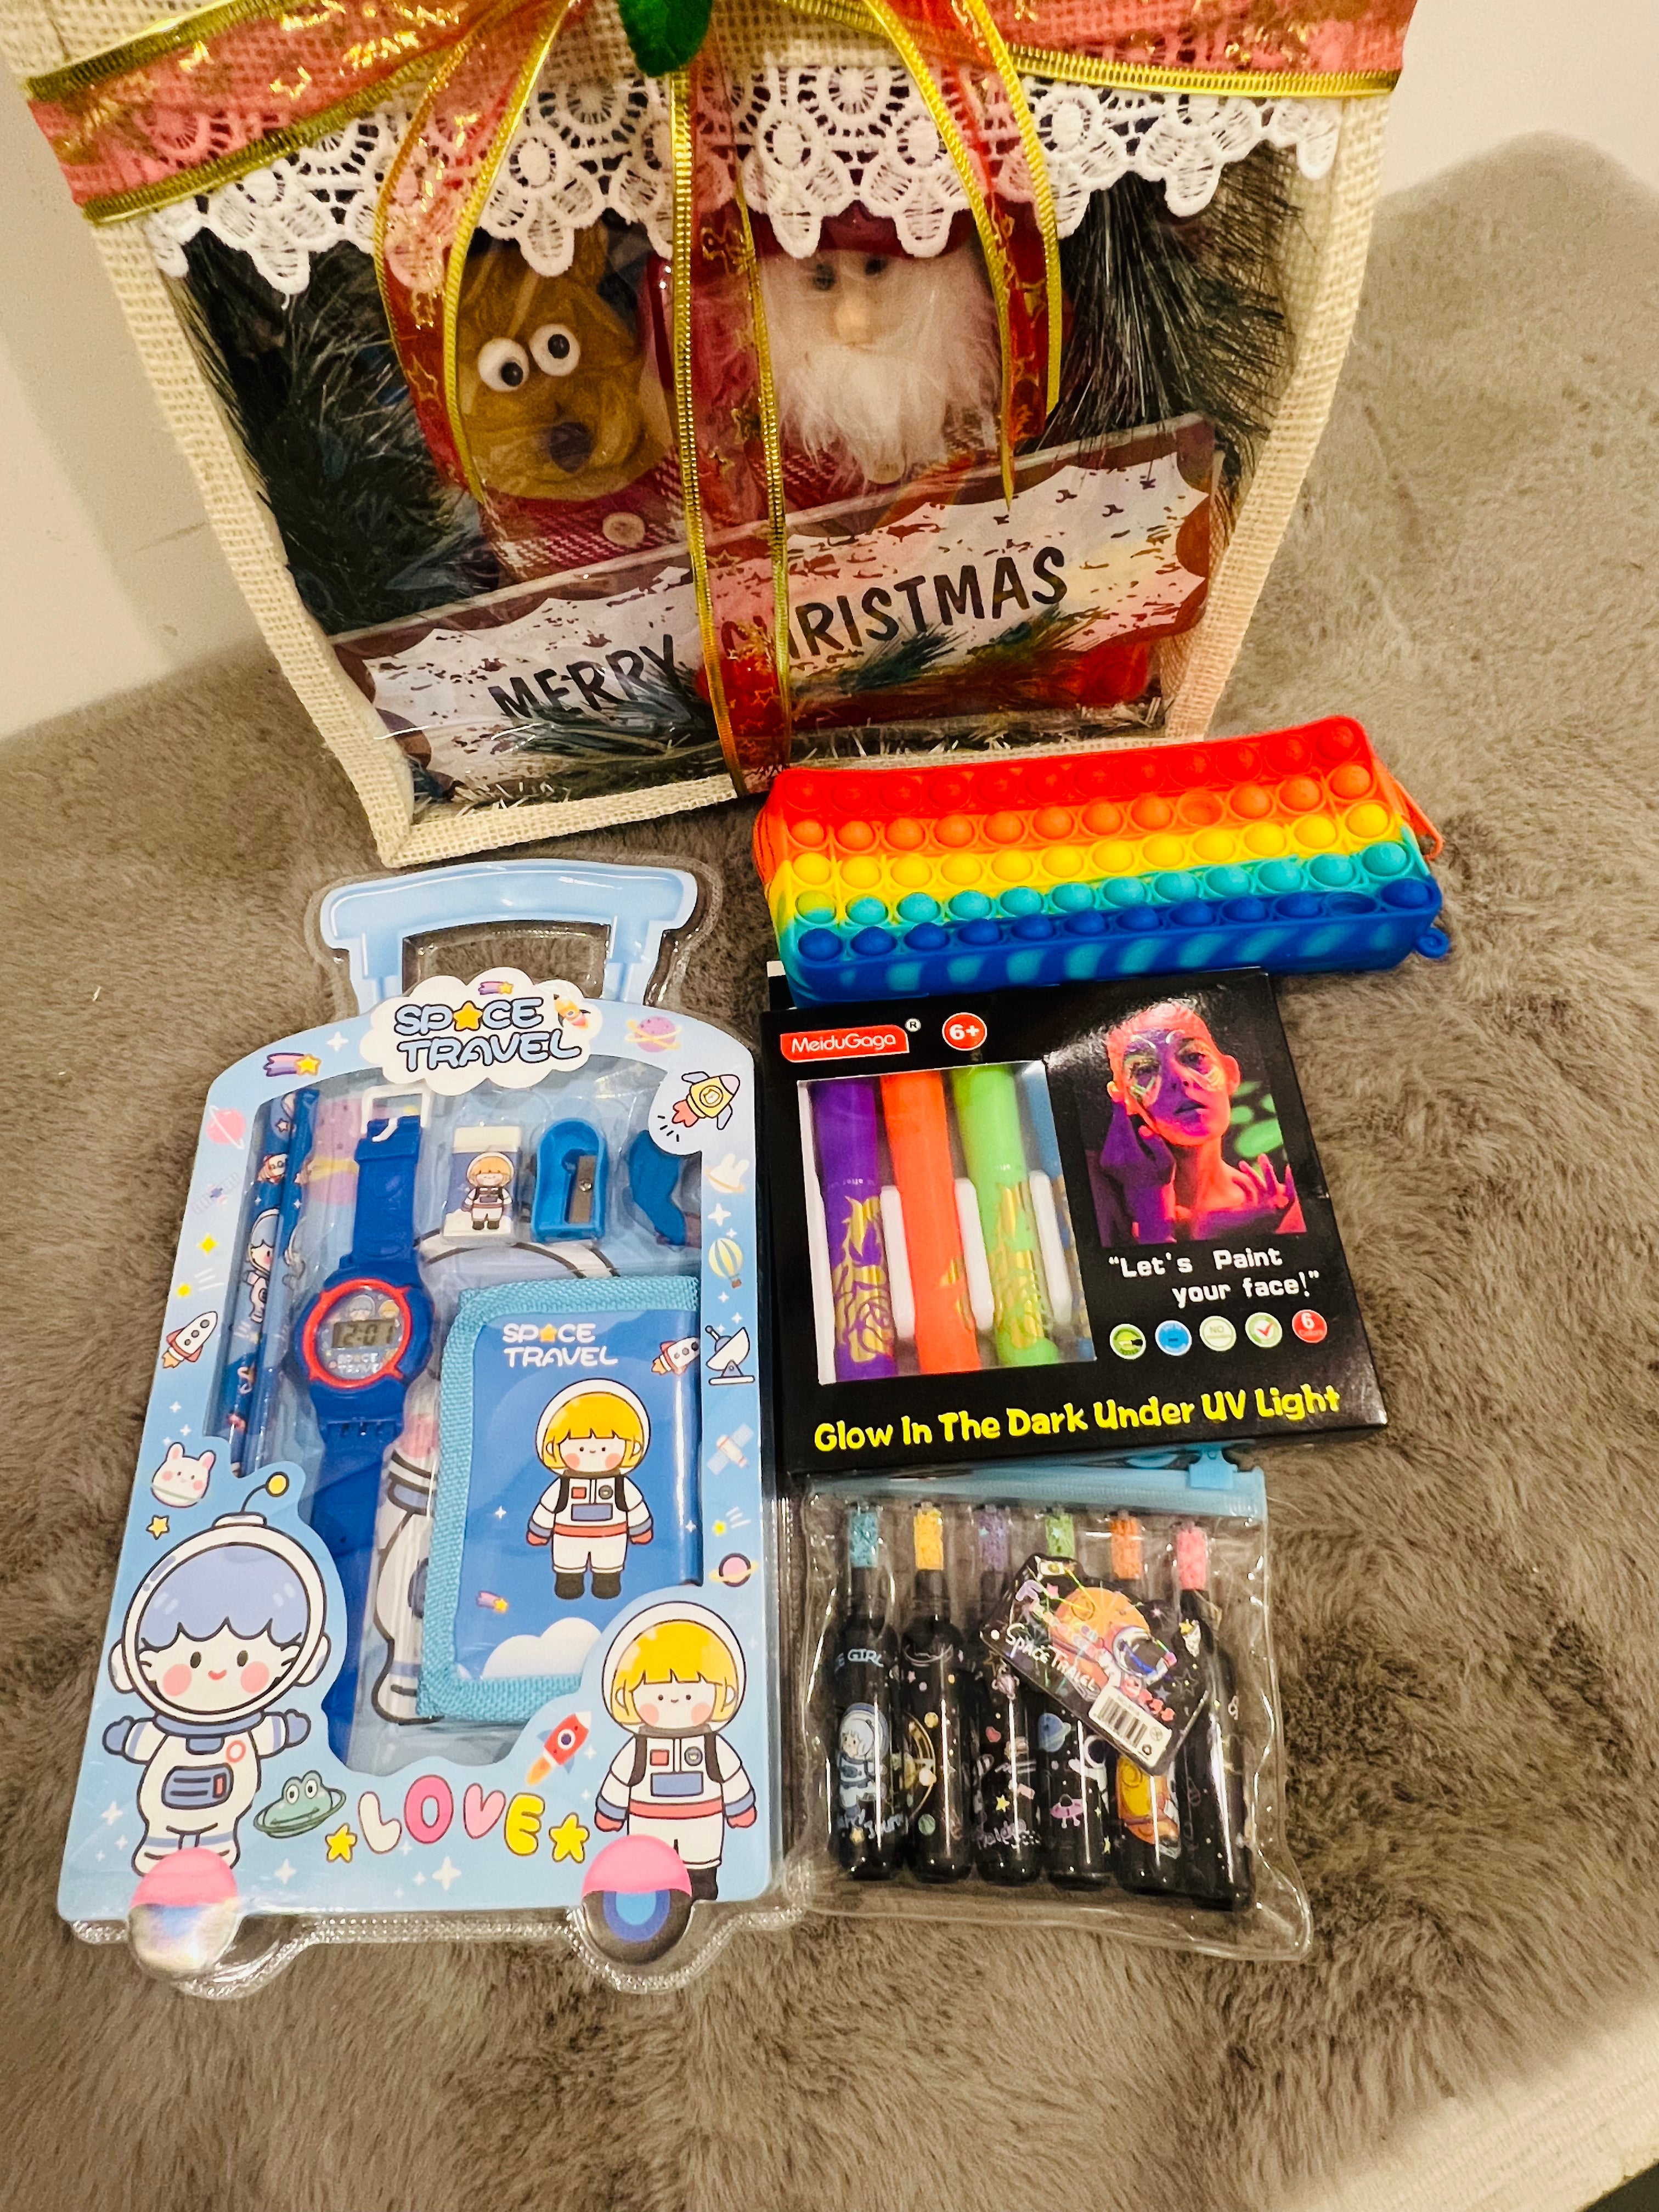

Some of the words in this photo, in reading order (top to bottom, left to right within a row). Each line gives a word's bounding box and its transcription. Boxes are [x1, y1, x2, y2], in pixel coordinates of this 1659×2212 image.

[488, 634, 680, 721] MERRY
[791, 1033, 896, 1054] MeiduGaga
[949, 1024, 980, 1040] 6+
[397, 1029, 582, 1071] TRAVEL
[1213, 1248, 1283, 1270] Paint
[1172, 1283, 1231, 1308] your
[1301, 1312, 1315, 1329] 6
[504, 1346, 618, 1368] TRAVEL
[815, 1420, 893, 1452] Glow
[901, 1416, 932, 1445] In
[938, 1410, 1000, 1442] The
[1006, 1403, 1088, 1436] Dark
[1093, 1396, 1194, 1429] Under
[1201, 1389, 1246, 1422] UV
[1255, 1383, 1340, 1421] Light
[358, 1774, 545, 1856] LOVE
